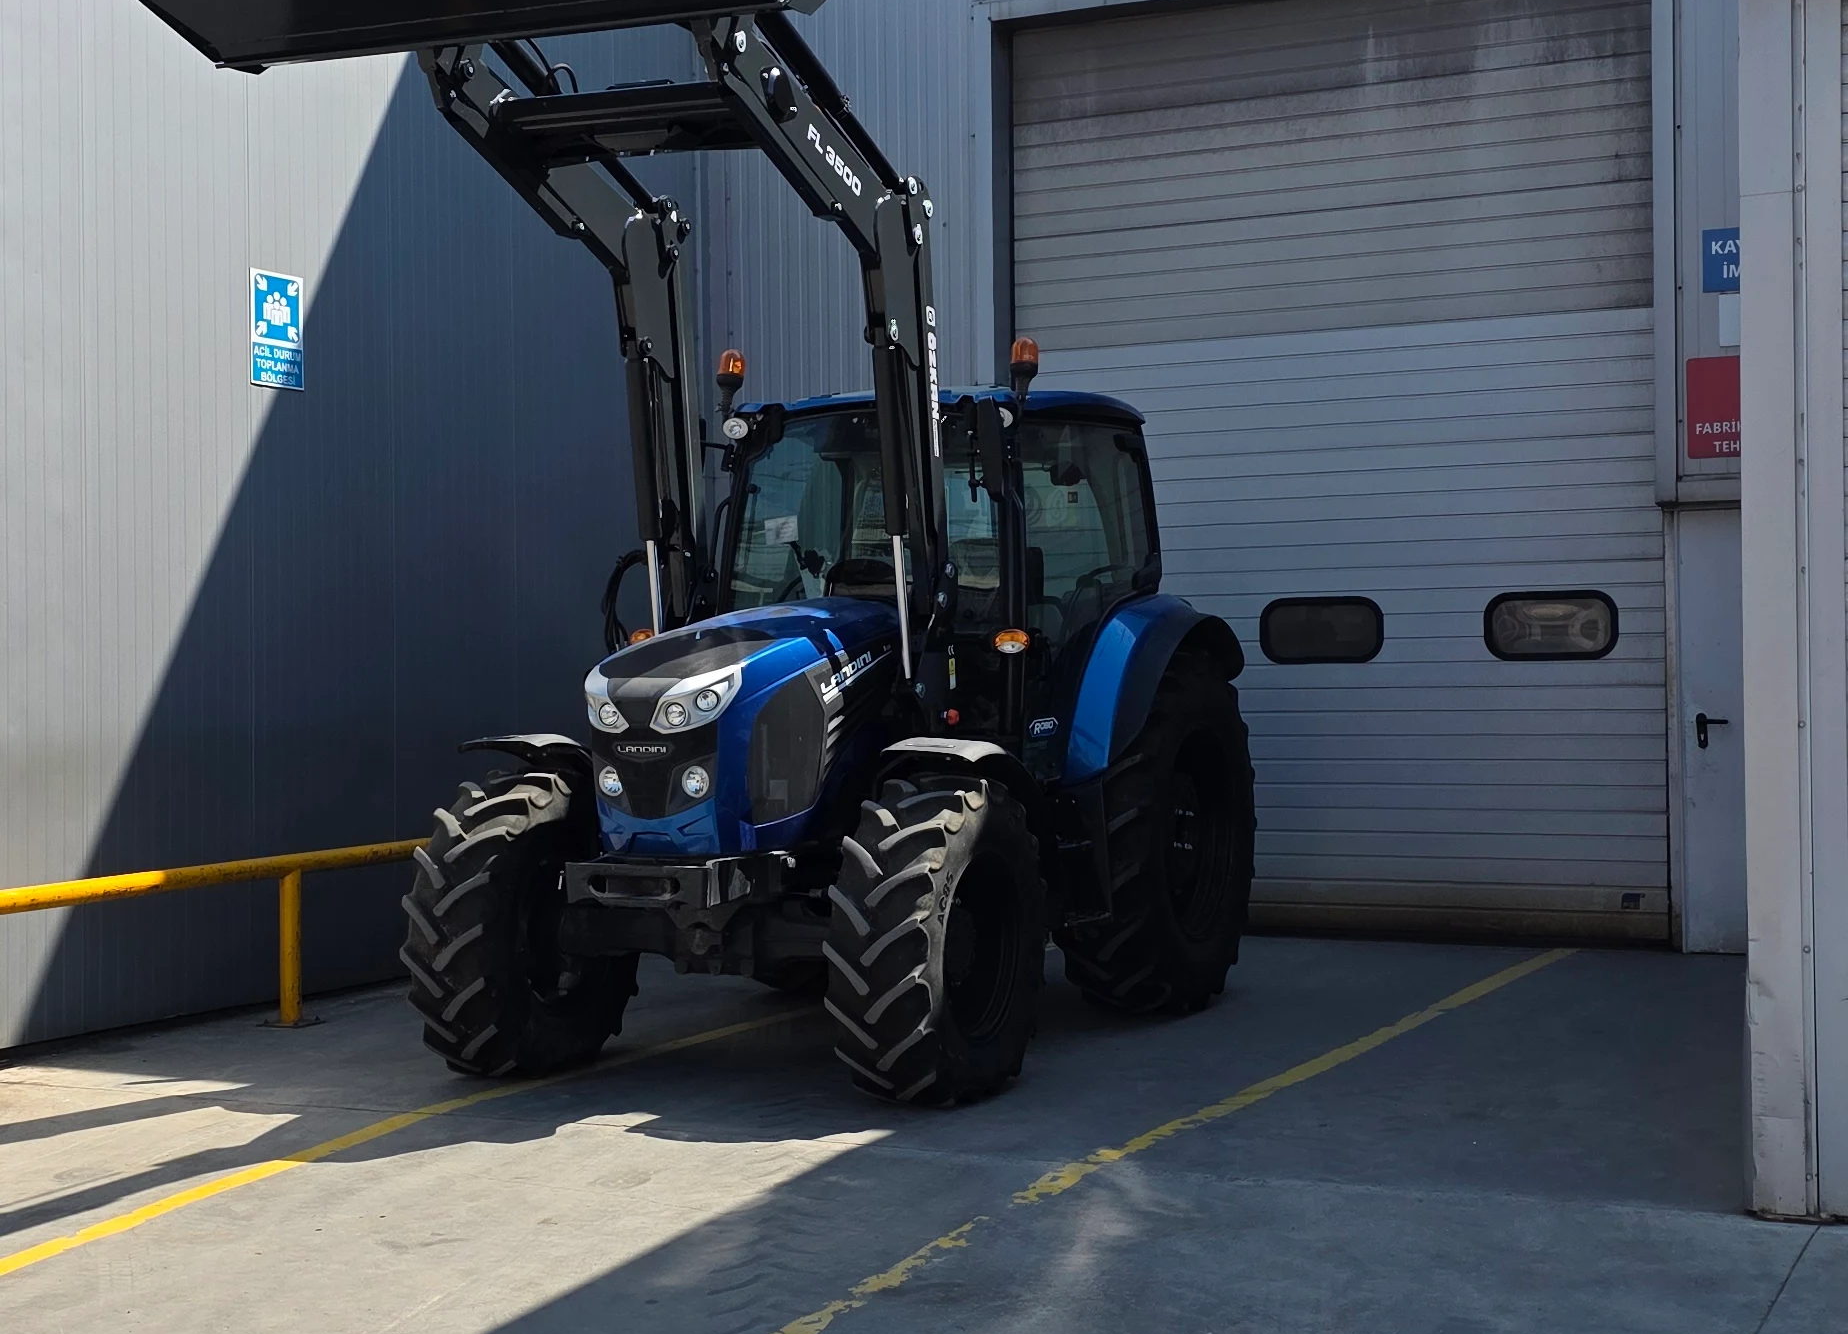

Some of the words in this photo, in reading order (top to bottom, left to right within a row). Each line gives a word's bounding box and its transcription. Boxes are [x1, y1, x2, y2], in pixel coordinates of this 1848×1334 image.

[807, 123, 824, 155] FL
[825, 145, 862, 197] 3500
[254, 345, 272, 358] ACİL
[273, 348, 301, 362] DURUM
[256, 358, 299, 374] TOPLANMA
[260, 372, 296, 385] BÖLGESİ
[1713, 440, 1740, 453] TEH
[820, 651, 872, 694] LANDINI
[616, 745, 667, 754] LANDINI
